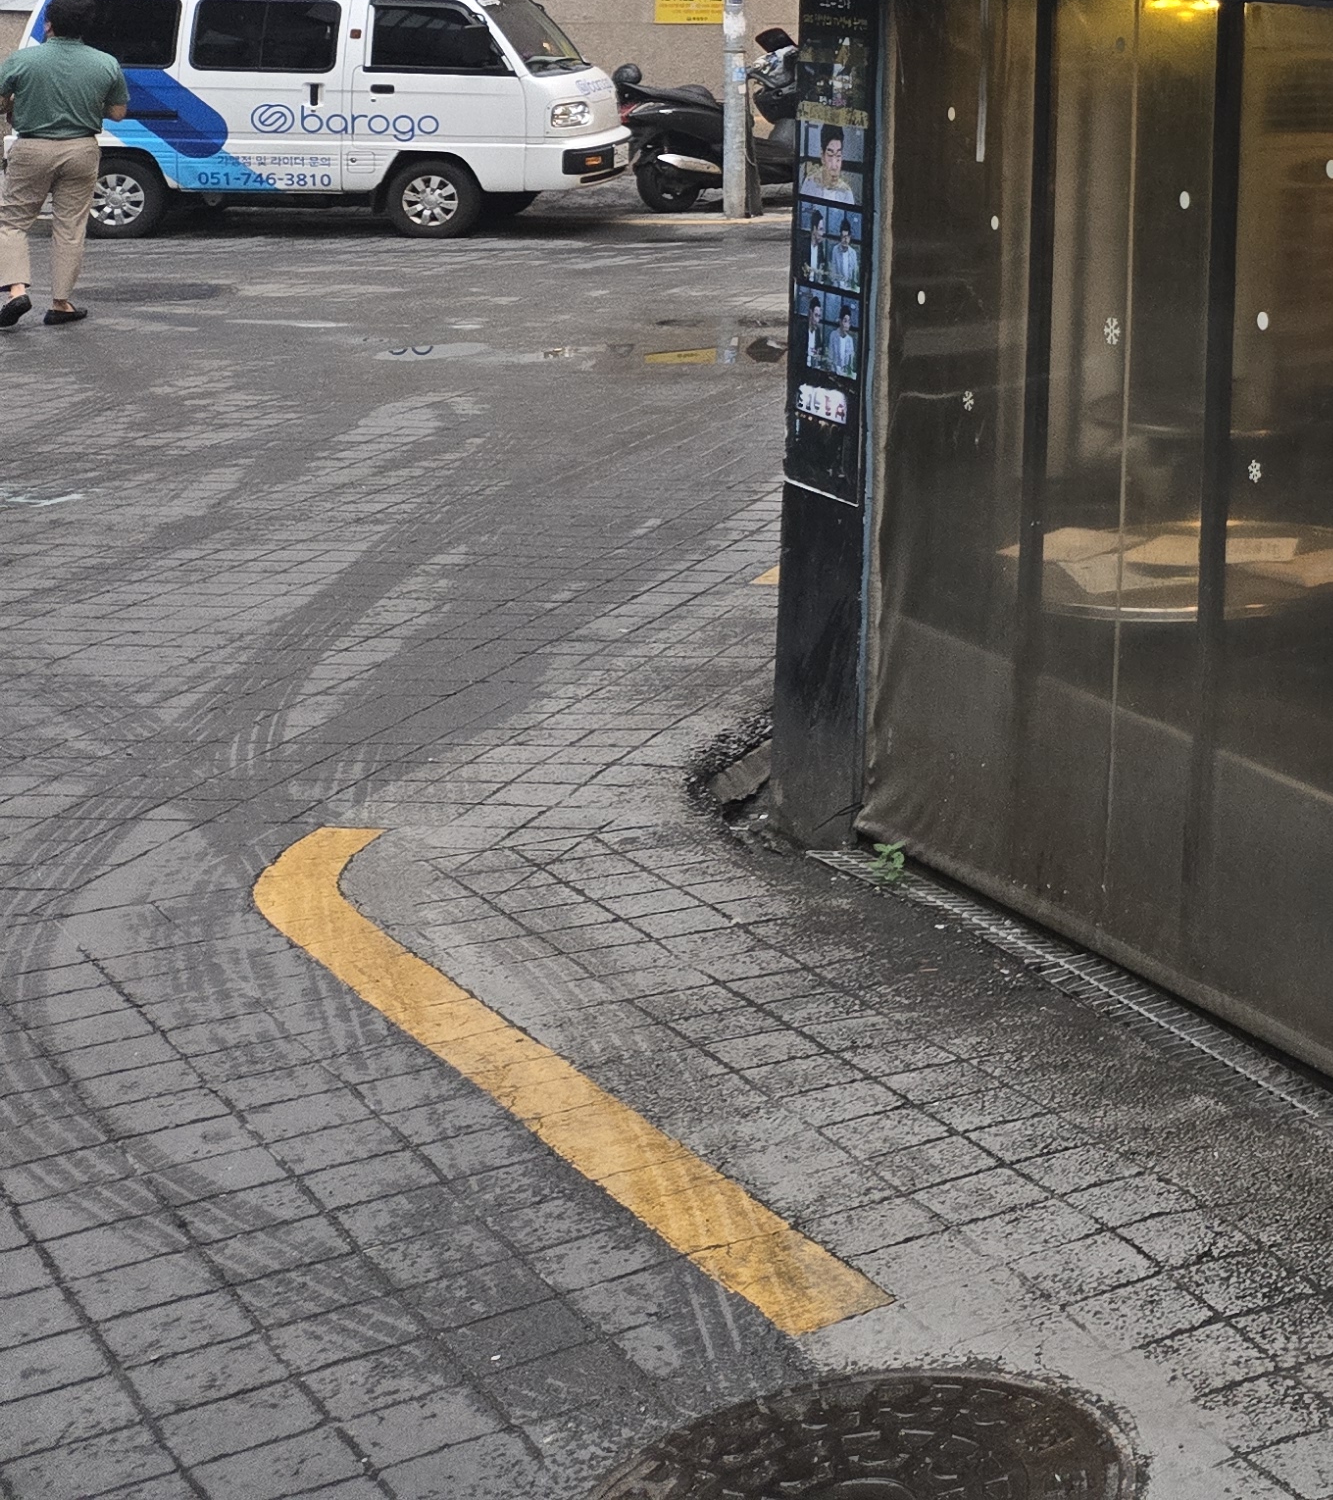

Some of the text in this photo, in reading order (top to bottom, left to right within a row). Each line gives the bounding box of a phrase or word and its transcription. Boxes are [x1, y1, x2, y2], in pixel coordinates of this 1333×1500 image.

[300, 105, 439, 142] barogo
[271, 156, 304, 167] 라이더
[198, 172, 331, 187] 051-746-3810
